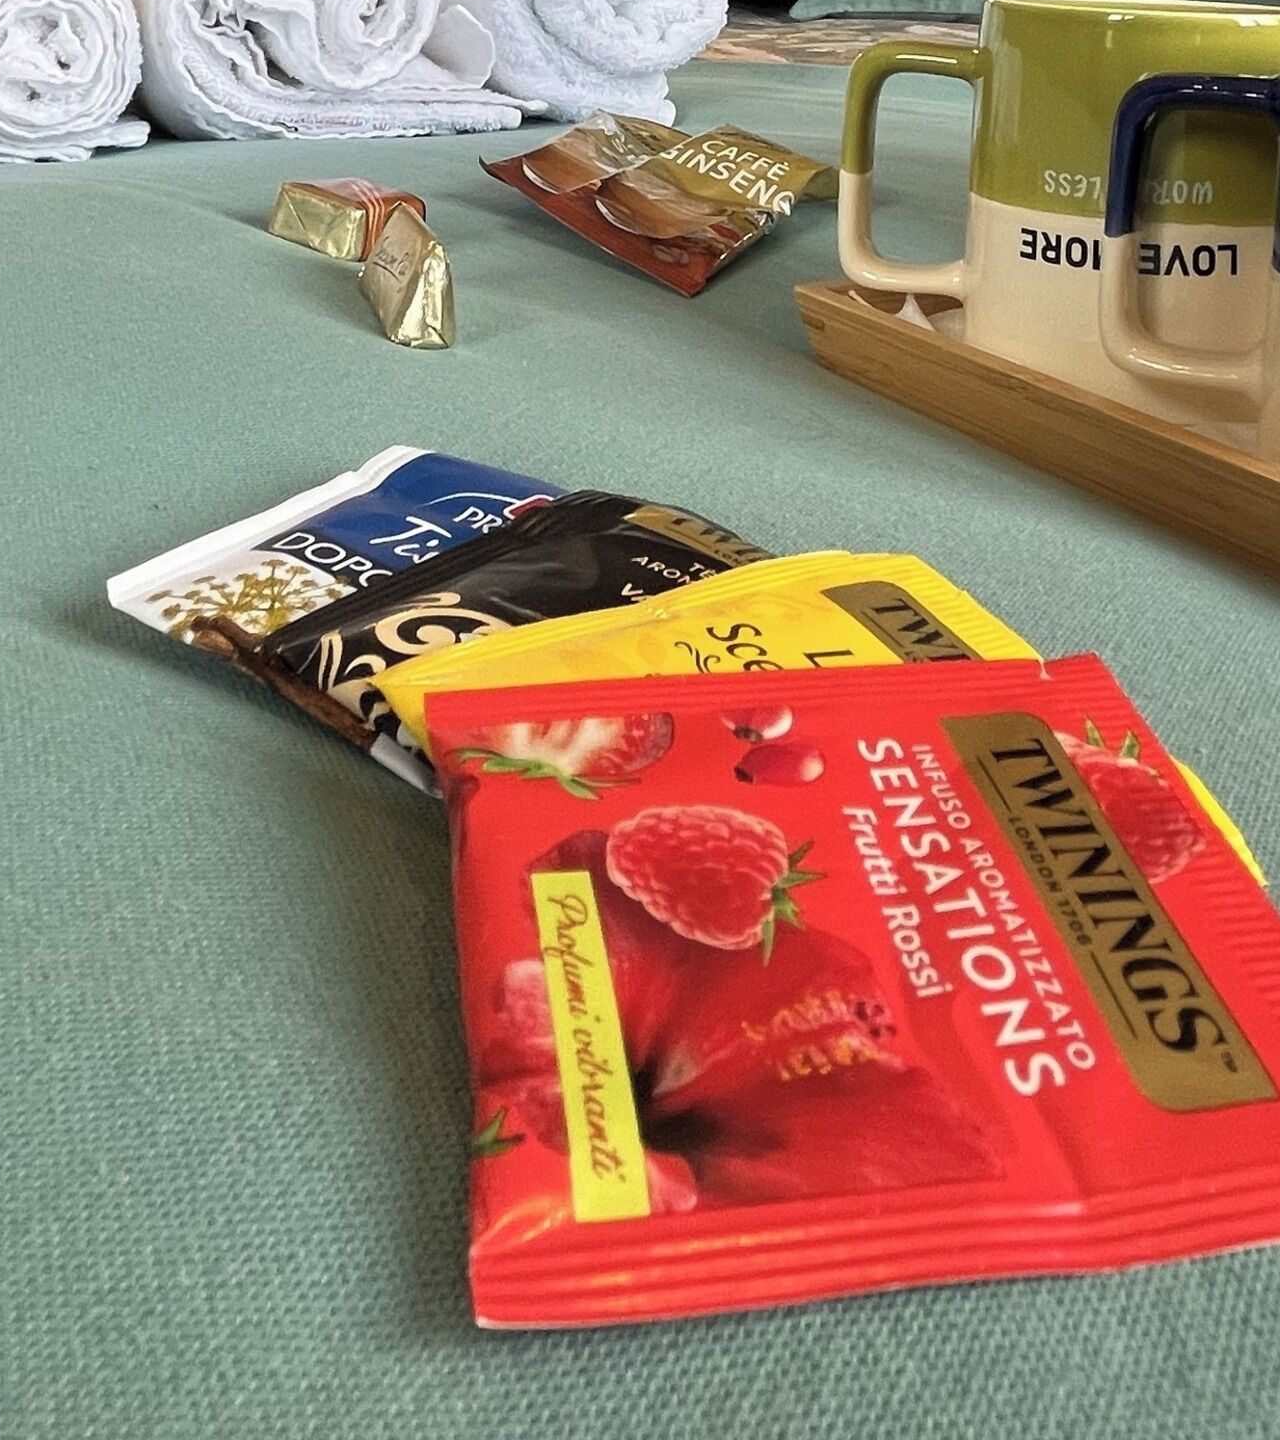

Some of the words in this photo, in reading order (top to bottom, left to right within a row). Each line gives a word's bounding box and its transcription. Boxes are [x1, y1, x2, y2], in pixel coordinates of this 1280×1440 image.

[1044, 169, 1102, 200] LESS
[1138, 244, 1238, 276] LOVE
[841, 806, 908, 896] Frutti
[881, 905, 954, 998] Rossi
[857, 738, 1066, 1097] SENSATIONS
[911, 744, 972, 830] INFUSO
[960, 837, 1096, 1071] AROMATIZZATO
[991, 738, 1228, 1053] TWININGS
[1008, 816, 1063, 893] LONDON
[543, 893, 605, 1024] Profumi
[572, 1026, 627, 1184] vibranti
